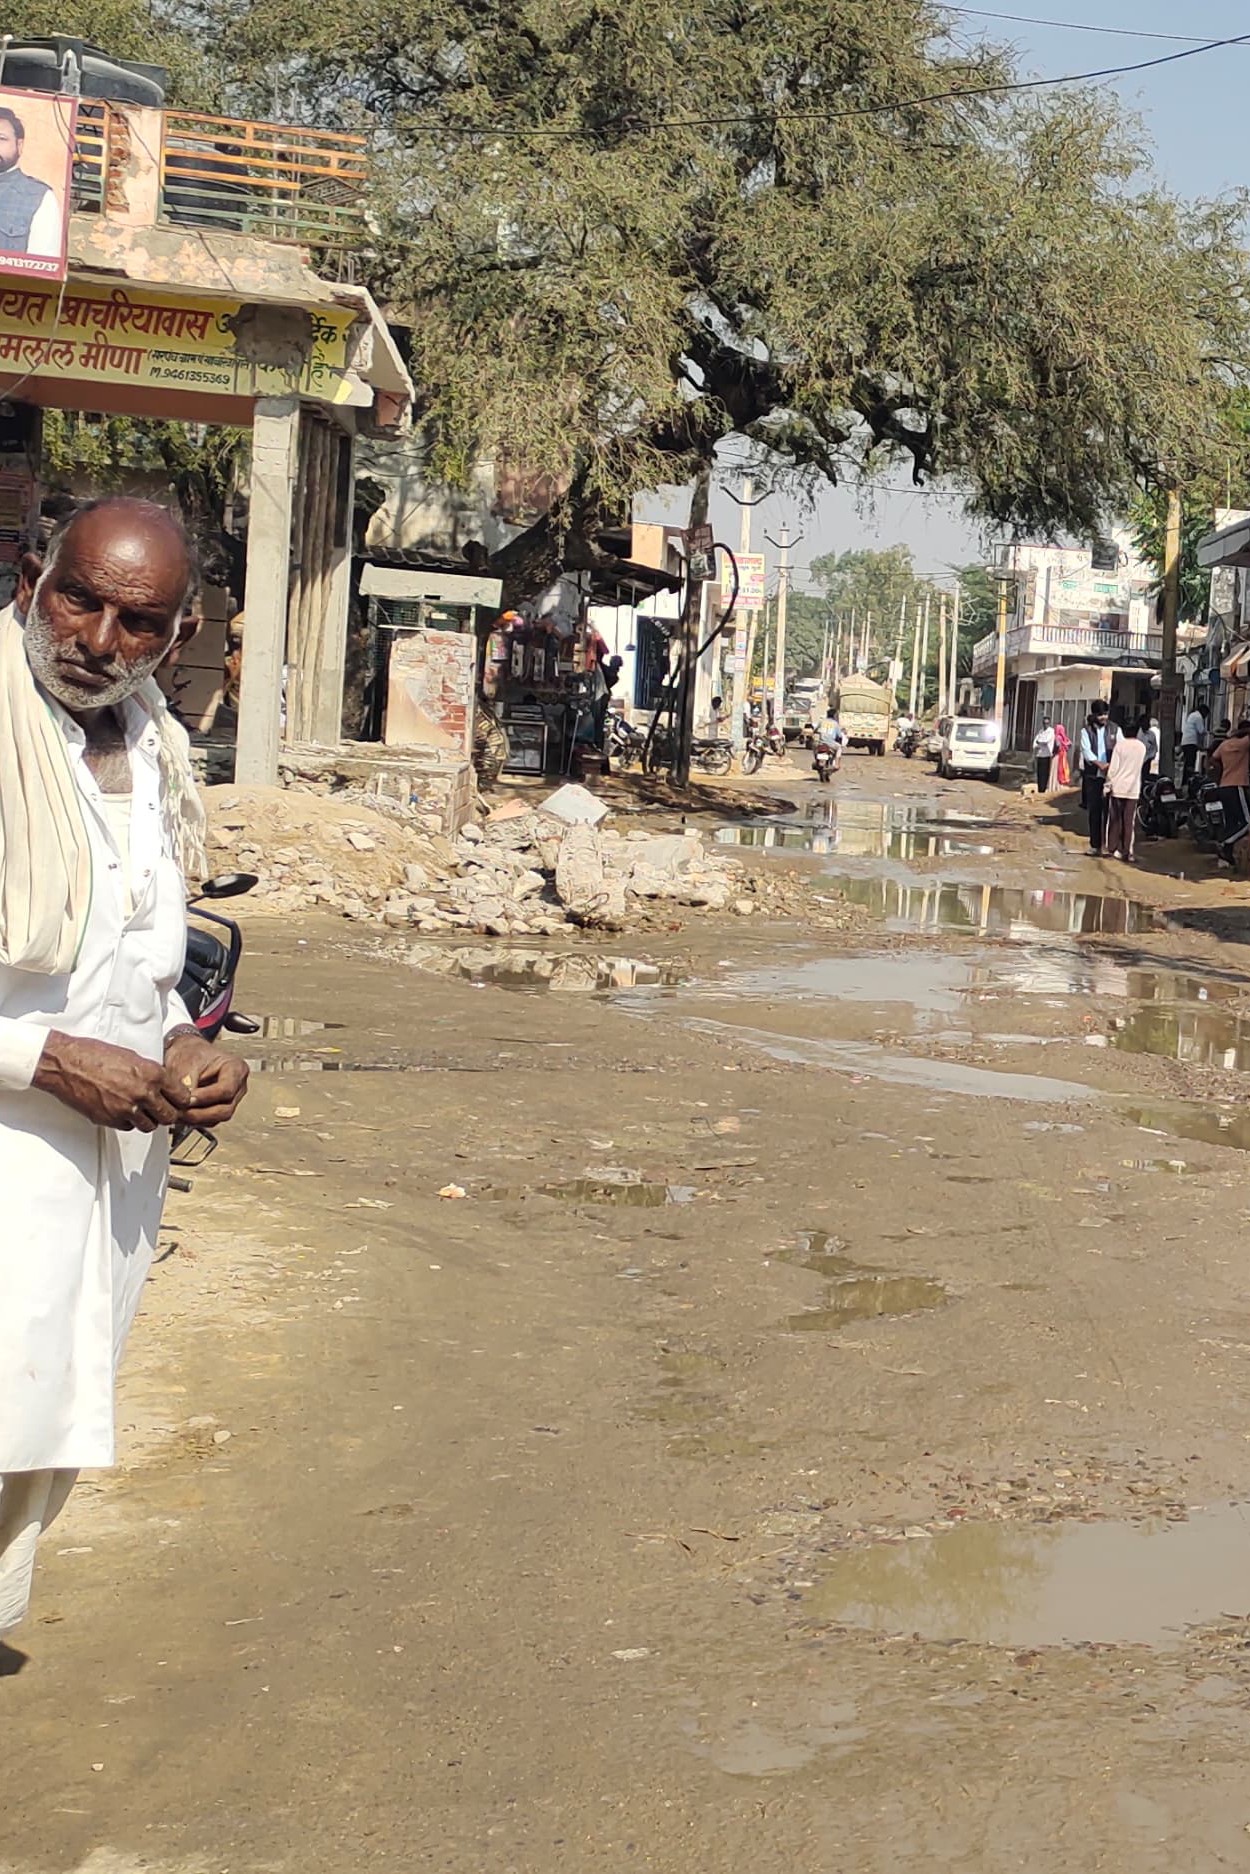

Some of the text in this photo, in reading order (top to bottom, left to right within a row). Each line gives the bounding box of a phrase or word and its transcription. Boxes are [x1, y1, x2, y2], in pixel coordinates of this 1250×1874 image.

[0, 288, 53, 326] यत
[0, 330, 148, 375] मलाल मीणा
